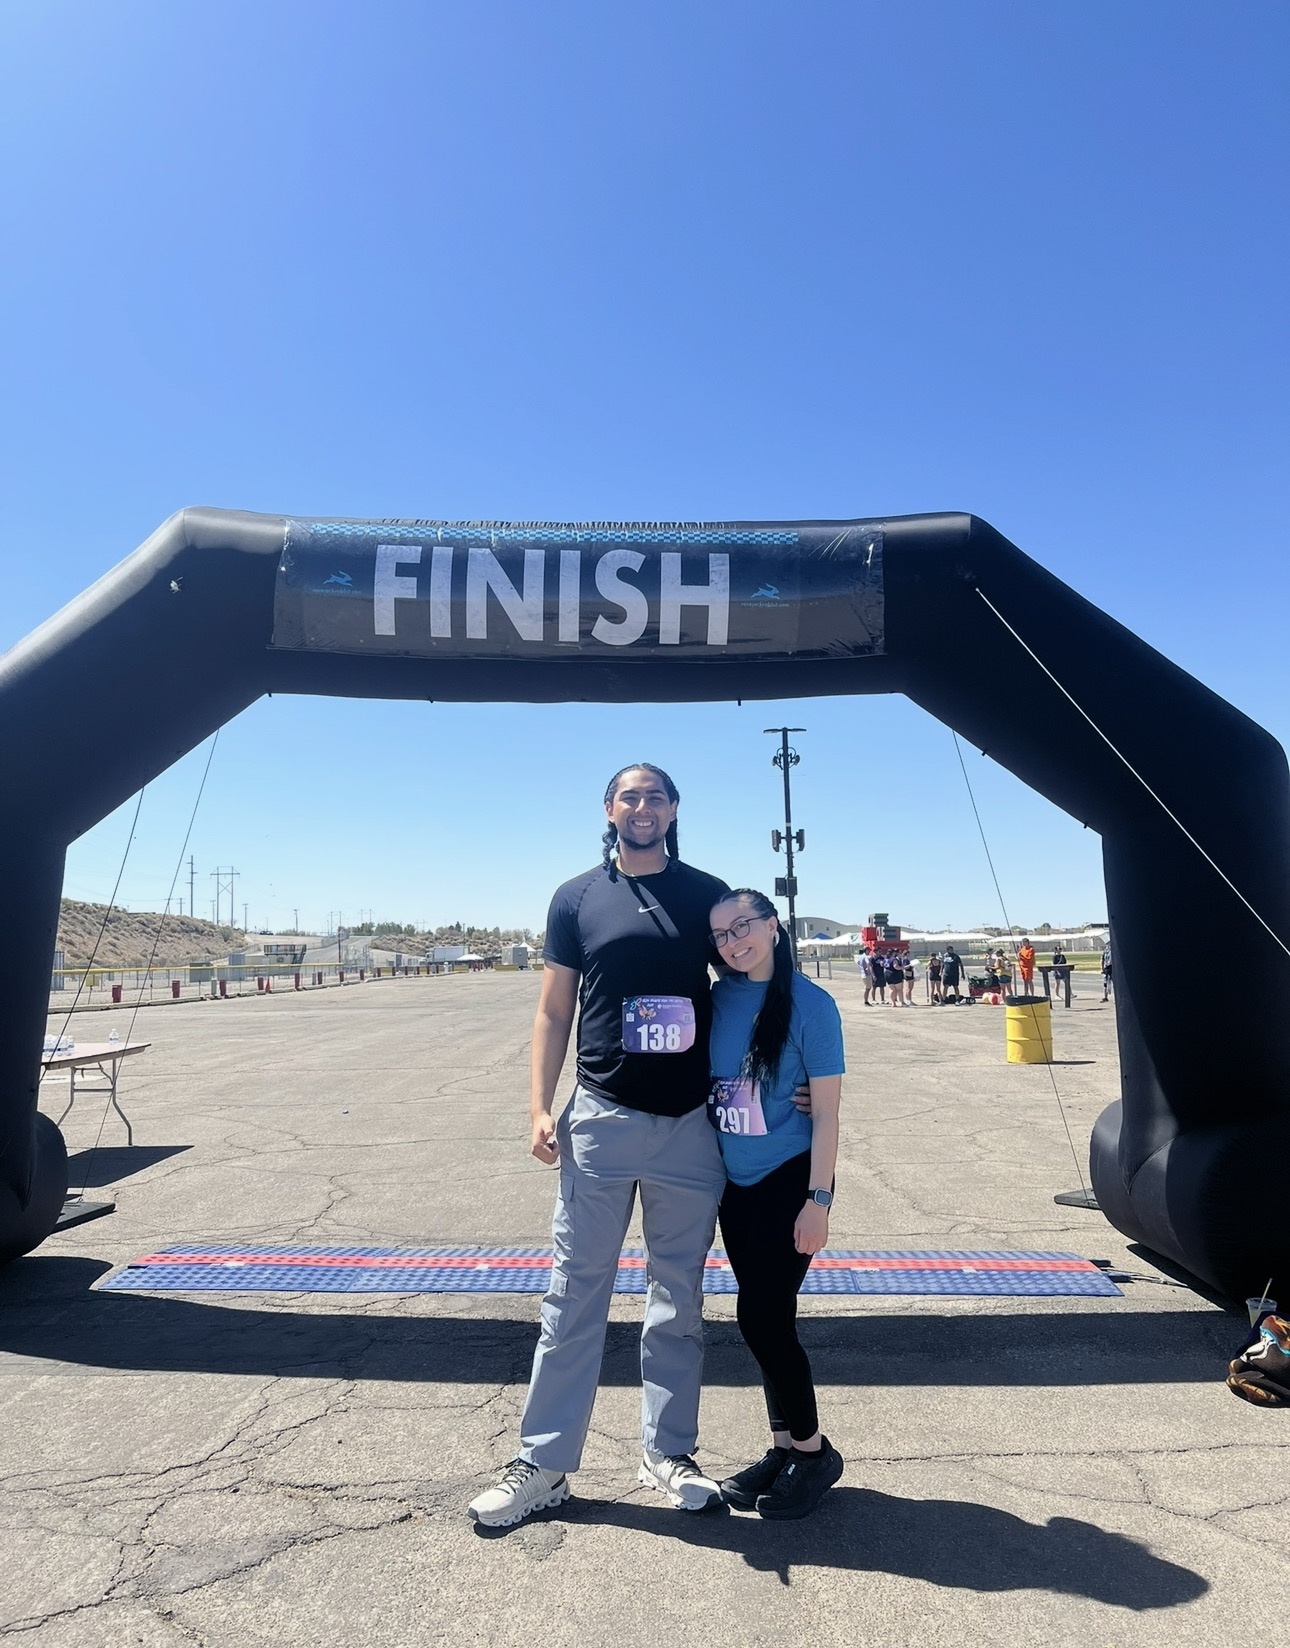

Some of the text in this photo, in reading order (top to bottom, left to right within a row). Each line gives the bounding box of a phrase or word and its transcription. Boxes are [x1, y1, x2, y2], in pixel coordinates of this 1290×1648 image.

[374, 545, 730, 646] FINISH
[636, 1023, 681, 1051] 138
[715, 1106, 751, 1134] 297
